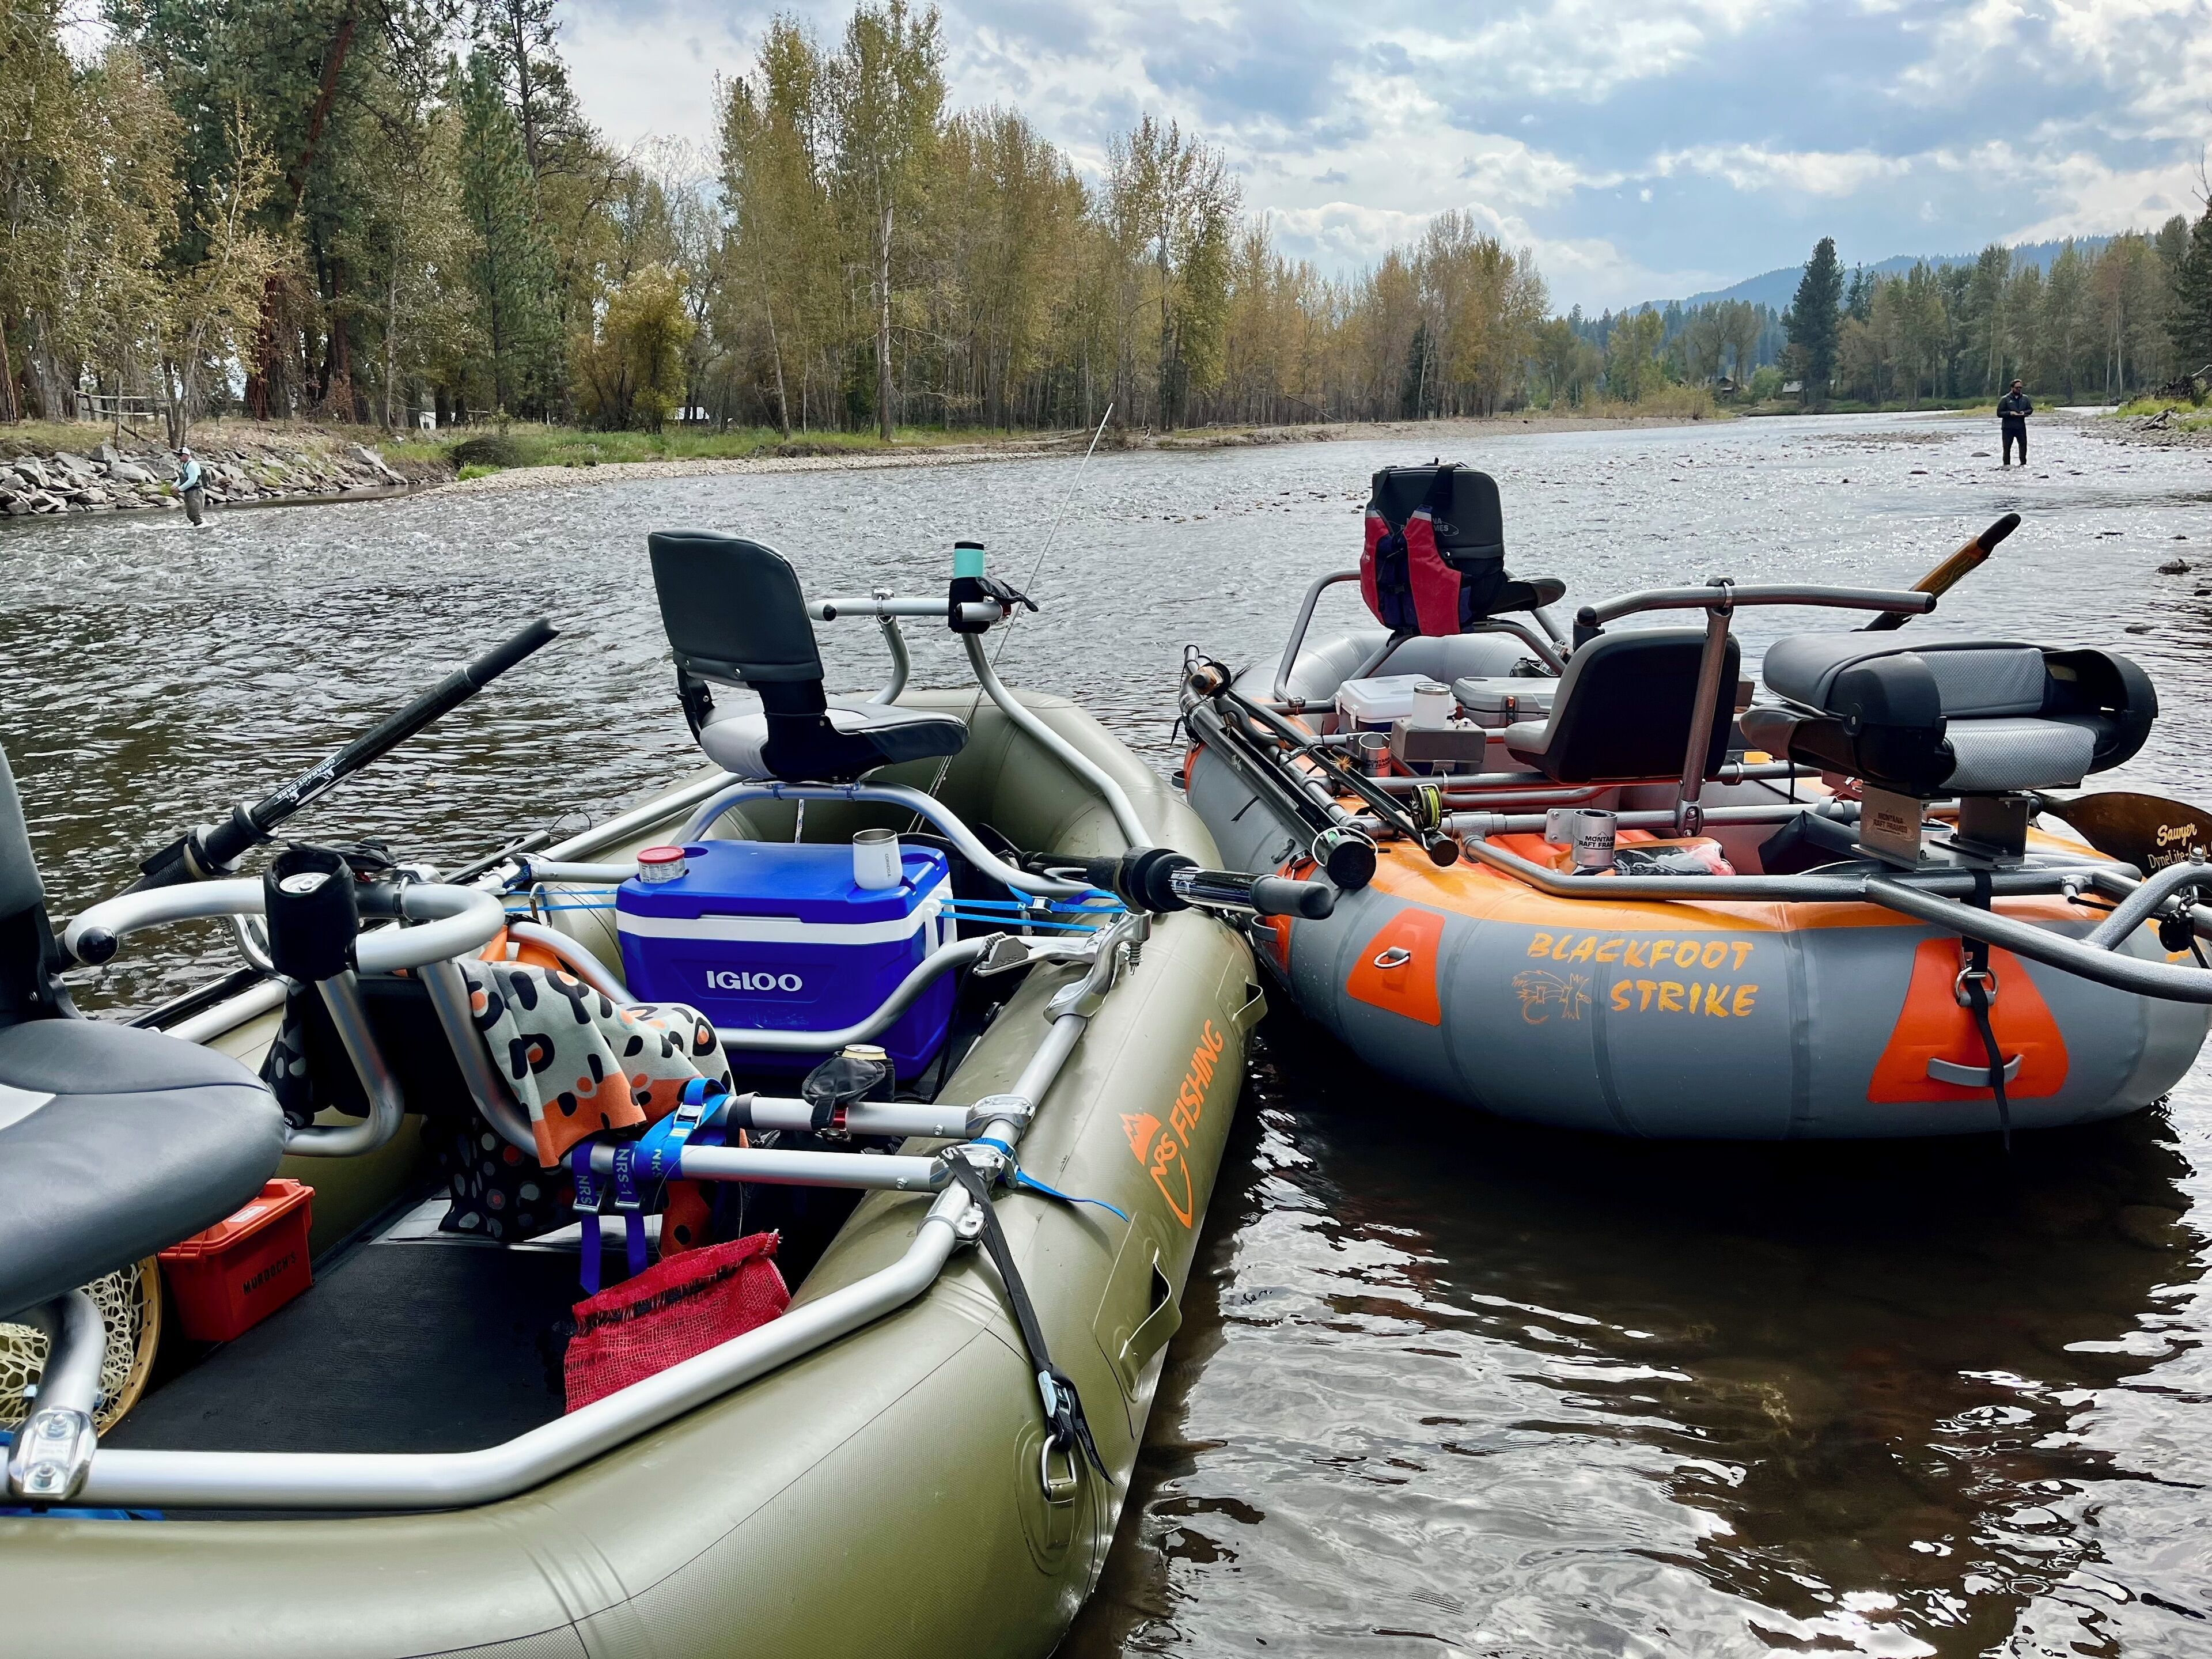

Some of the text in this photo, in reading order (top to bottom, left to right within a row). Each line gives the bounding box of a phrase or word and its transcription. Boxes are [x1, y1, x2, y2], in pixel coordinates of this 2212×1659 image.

[276, 758, 335, 800] CATARACT OARS
[1873, 819, 1907, 834] RAFT FRAMES
[1878, 812, 1903, 824] MONTANA
[2156, 823, 2198, 847] Sawyer
[1527, 933, 1755, 971] BLACKFOOT
[706, 971, 803, 992] IGLOO
[1610, 980, 1759, 1018] STRIKE
[1169, 1018, 1224, 1149] FISHING
[652, 1149, 662, 1178] NRS
[577, 1175, 593, 1205] NRS
